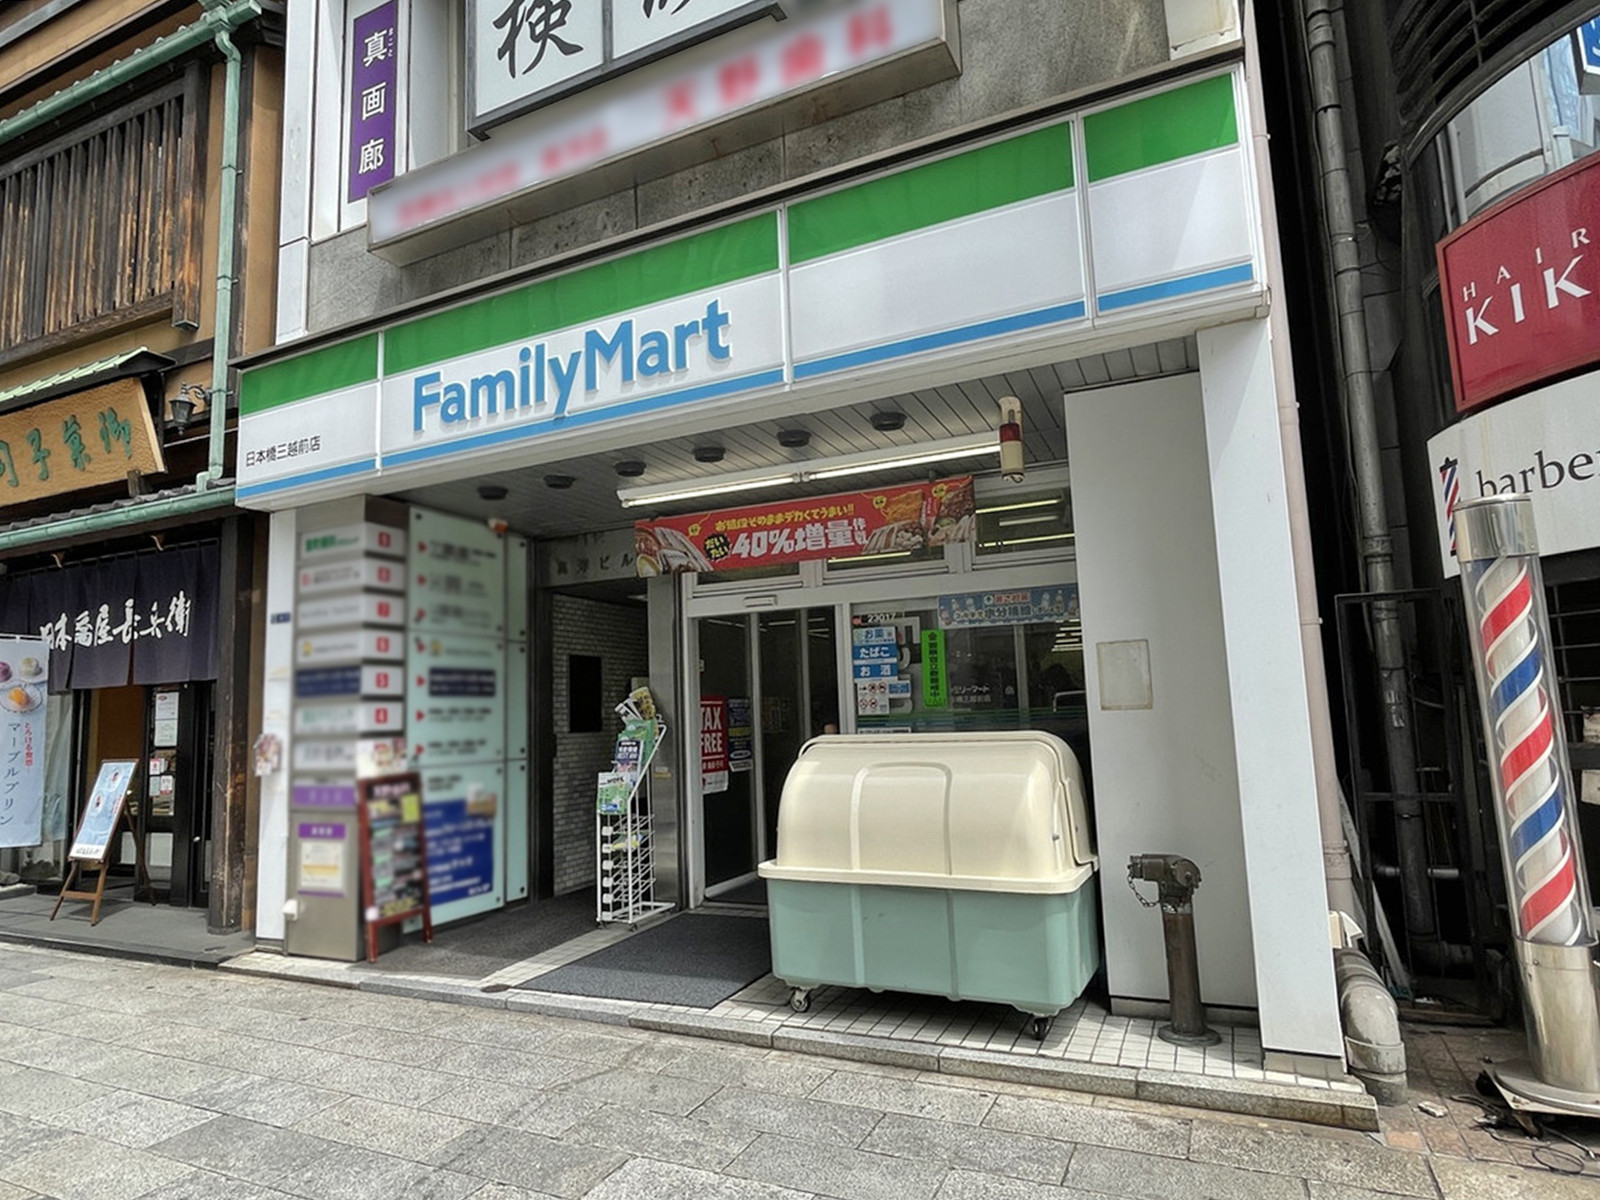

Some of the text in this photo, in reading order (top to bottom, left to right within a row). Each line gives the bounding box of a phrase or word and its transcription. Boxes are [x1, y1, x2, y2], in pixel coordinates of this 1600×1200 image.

[358, 29, 388, 175] 真画廊
[1462, 227, 1592, 302] HAIR
[413, 299, 731, 433] FamilyMart
[245, 435, 321, 468] 日本橋三越前店
[1476, 450, 1600, 498] barbe
[731, 518, 855, 559] 40%増量
[859, 646, 890, 659] たばこ
[0, 721, 21, 826] マーブルプリン
